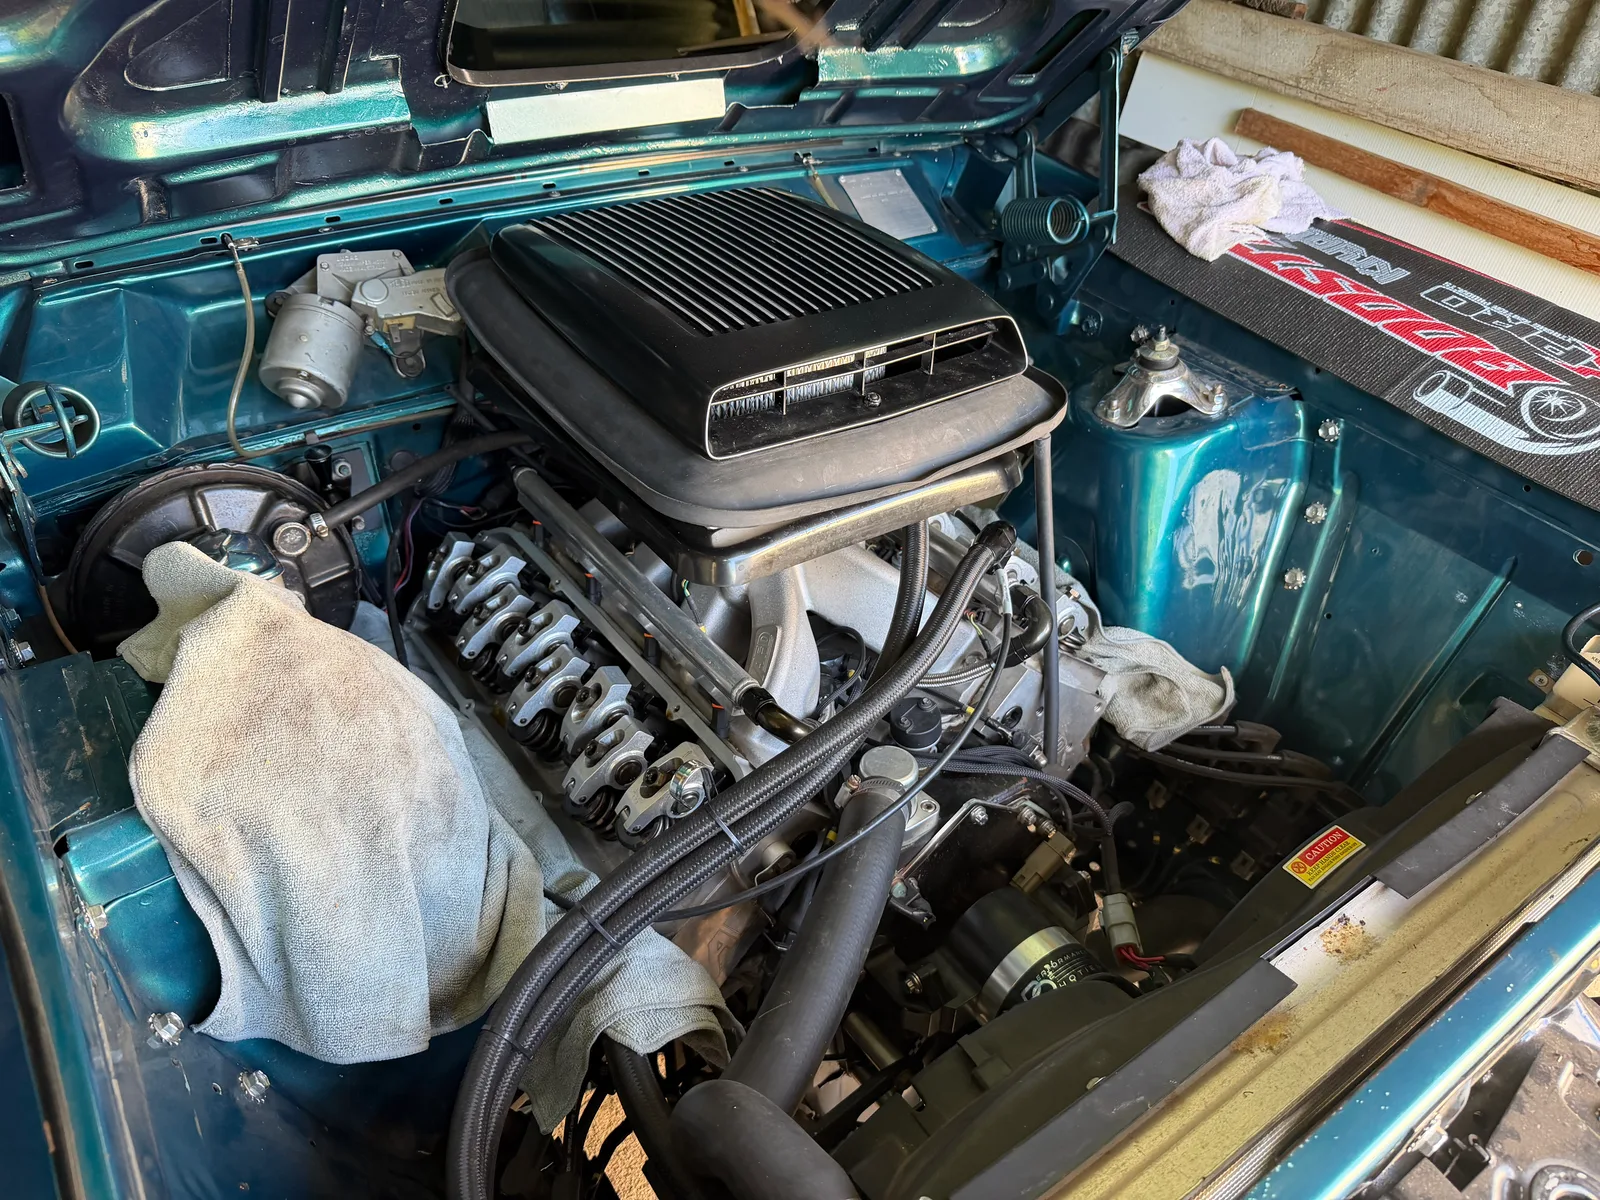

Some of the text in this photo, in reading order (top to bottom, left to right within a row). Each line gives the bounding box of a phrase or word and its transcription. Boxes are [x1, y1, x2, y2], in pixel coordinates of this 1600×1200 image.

[1228, 238, 1572, 398] BOOST
[1305, 831, 1343, 860] CAUTION
[1307, 862, 1321, 876] KEEP
[1320, 851, 1337, 865] HANDS
[1335, 841, 1351, 853] CLEAR
